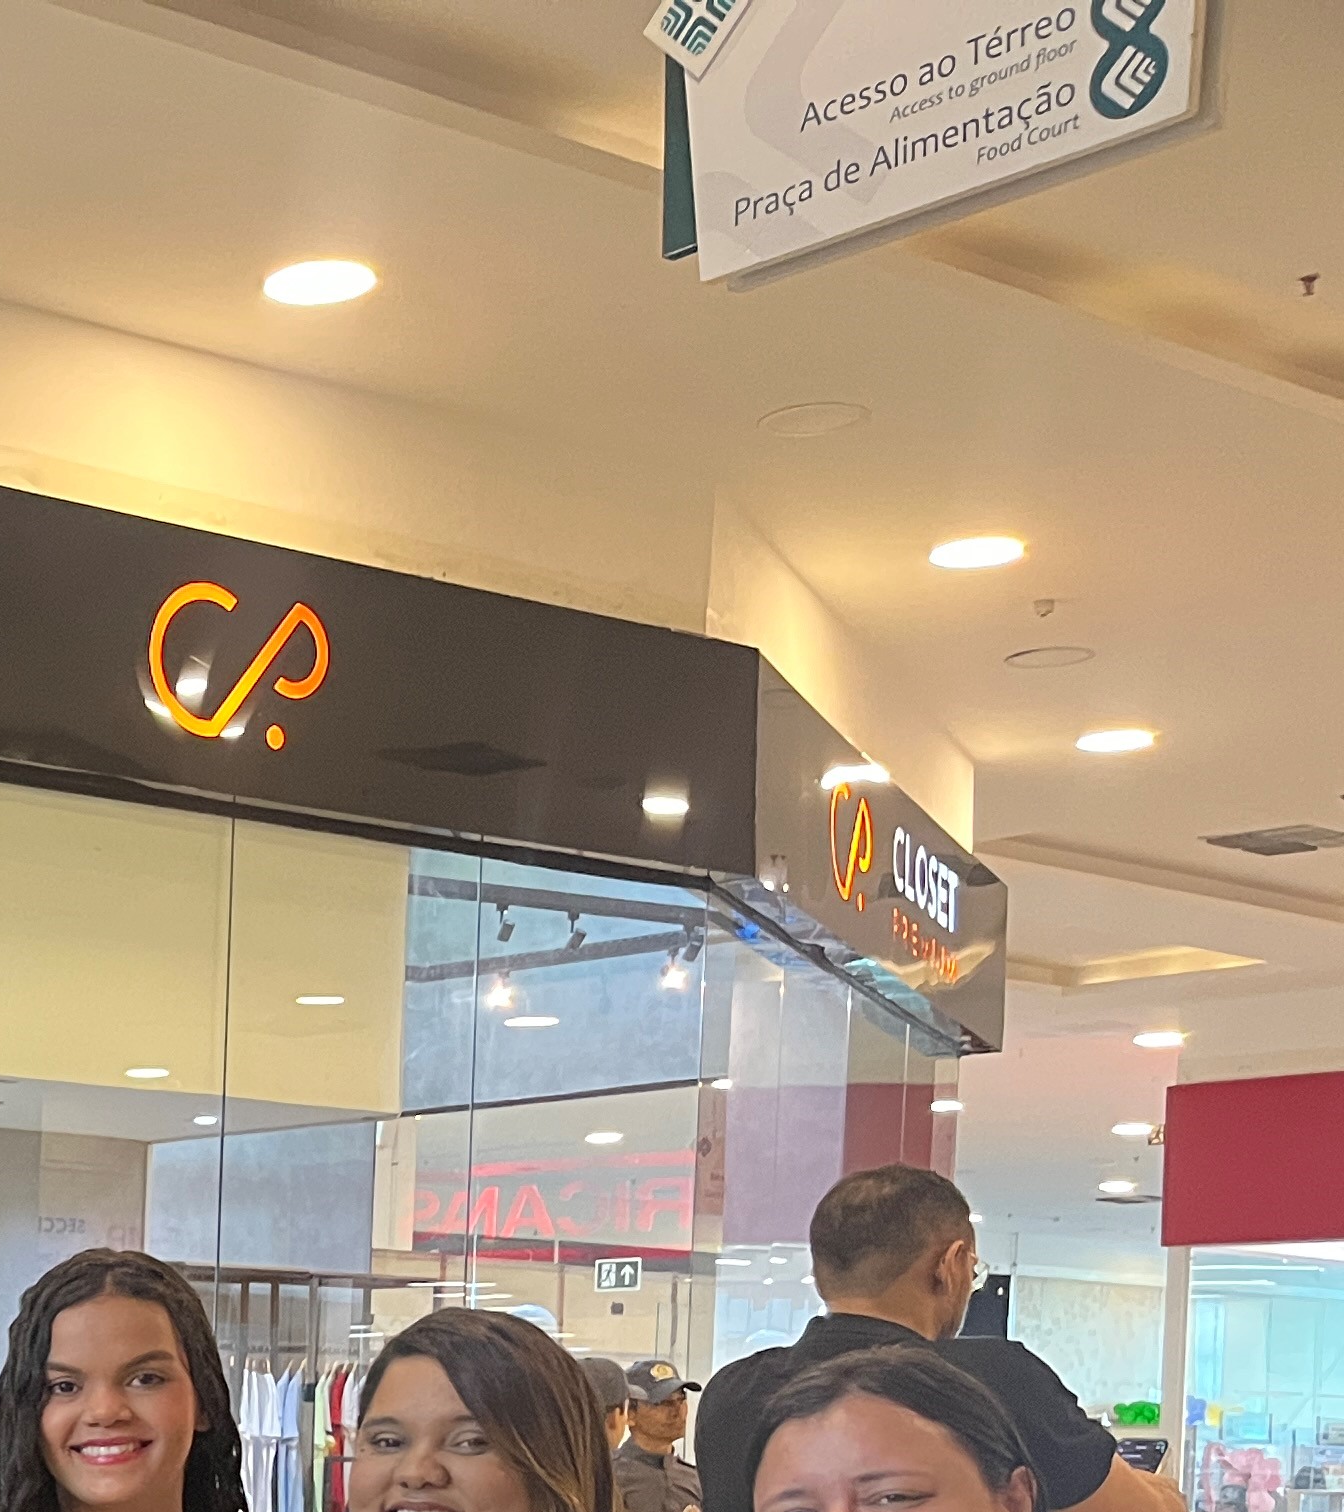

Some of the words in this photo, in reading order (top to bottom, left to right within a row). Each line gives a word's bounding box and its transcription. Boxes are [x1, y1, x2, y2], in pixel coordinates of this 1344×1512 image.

[799, 73, 908, 133] Acesso
[918, 53, 957, 86] ao
[966, 5, 1076, 67] Térreo
[889, 89, 944, 123] Access
[948, 80, 966, 98] to
[969, 55, 1032, 97] ground
[1035, 37, 1078, 71] floor
[734, 178, 813, 227] Praça
[823, 158, 861, 192] de
[869, 79, 1076, 179] Alimentação
[975, 131, 1023, 166] Food
[1026, 113, 1081, 147] Court
[892, 826, 960, 933] CLOSET
